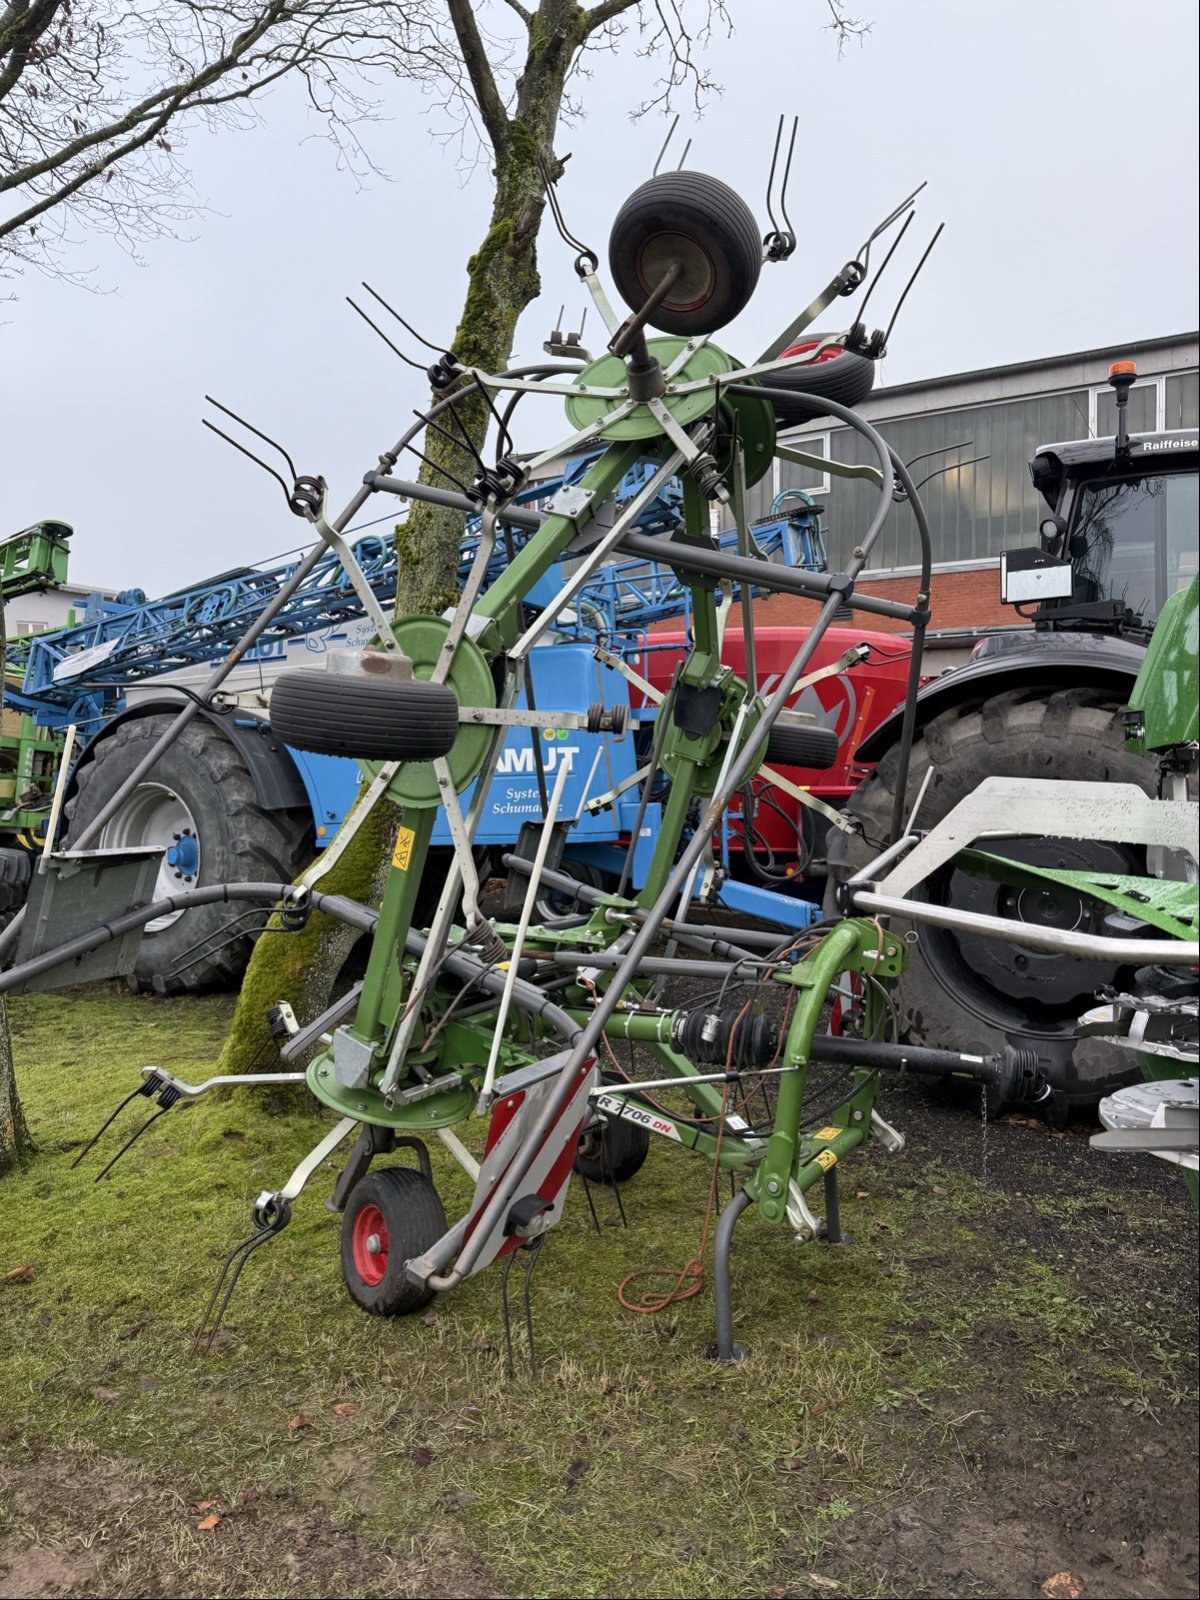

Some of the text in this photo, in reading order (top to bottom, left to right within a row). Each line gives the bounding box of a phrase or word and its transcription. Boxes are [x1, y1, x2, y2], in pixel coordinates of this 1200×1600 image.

[506, 788, 549, 802] Syste
[614, 1102, 651, 1123] 7706
[652, 1120, 672, 1133] DN
